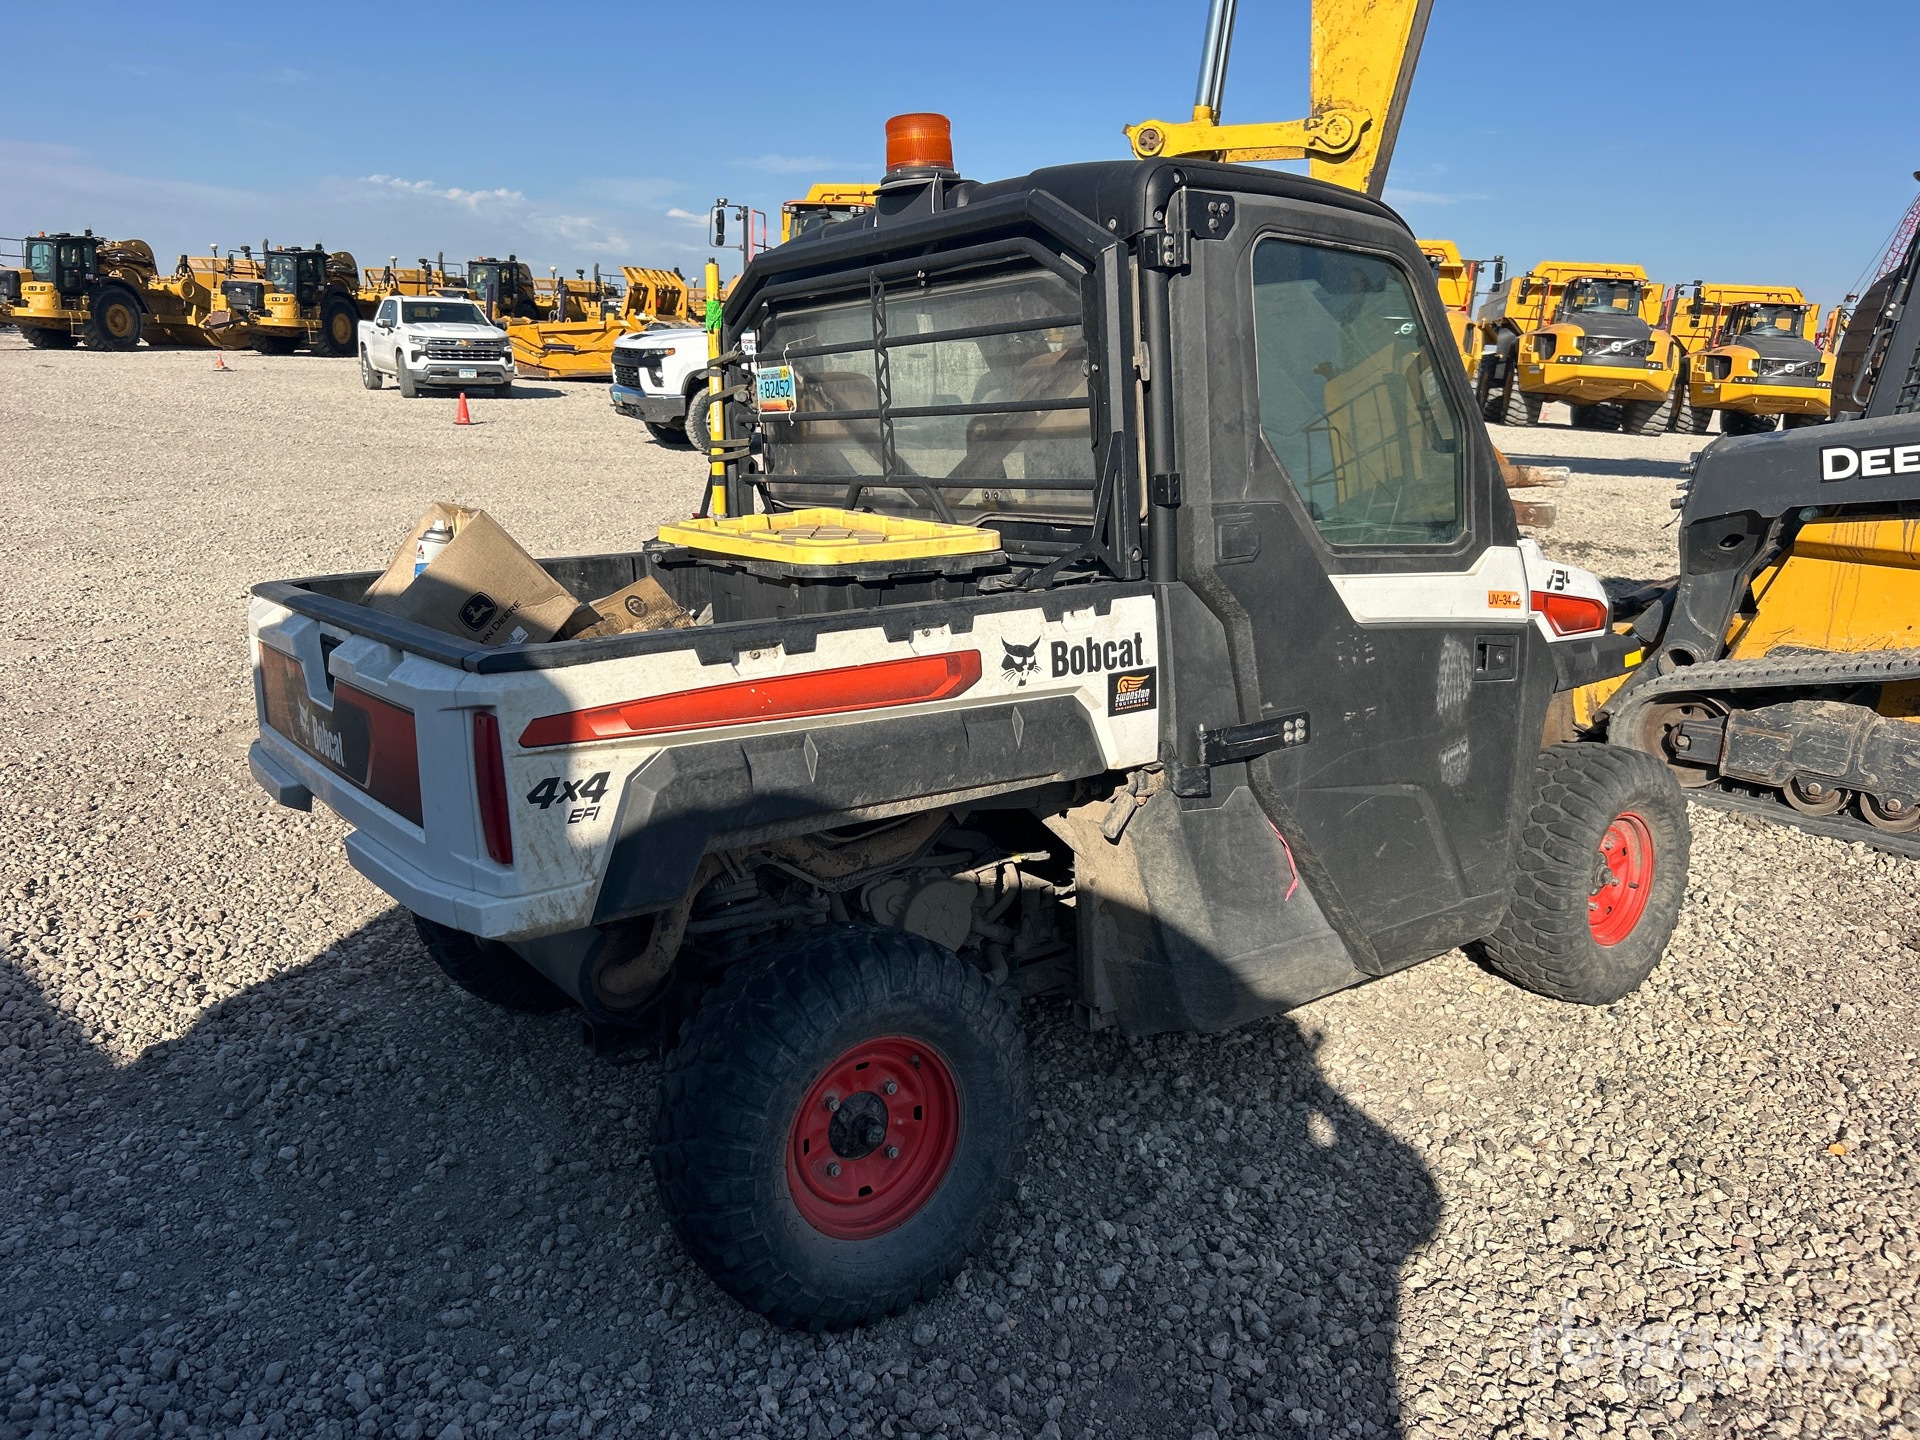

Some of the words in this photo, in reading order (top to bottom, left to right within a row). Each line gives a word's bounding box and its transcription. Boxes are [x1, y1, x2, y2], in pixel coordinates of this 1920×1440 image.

[764, 380, 790, 399] 82452
[491, 600, 522, 631] DEERE
[1051, 632, 1144, 678] Bobcat
[311, 714, 345, 768] Bobcat
[526, 771, 611, 809] 4x4
[566, 806, 601, 824] EFI
